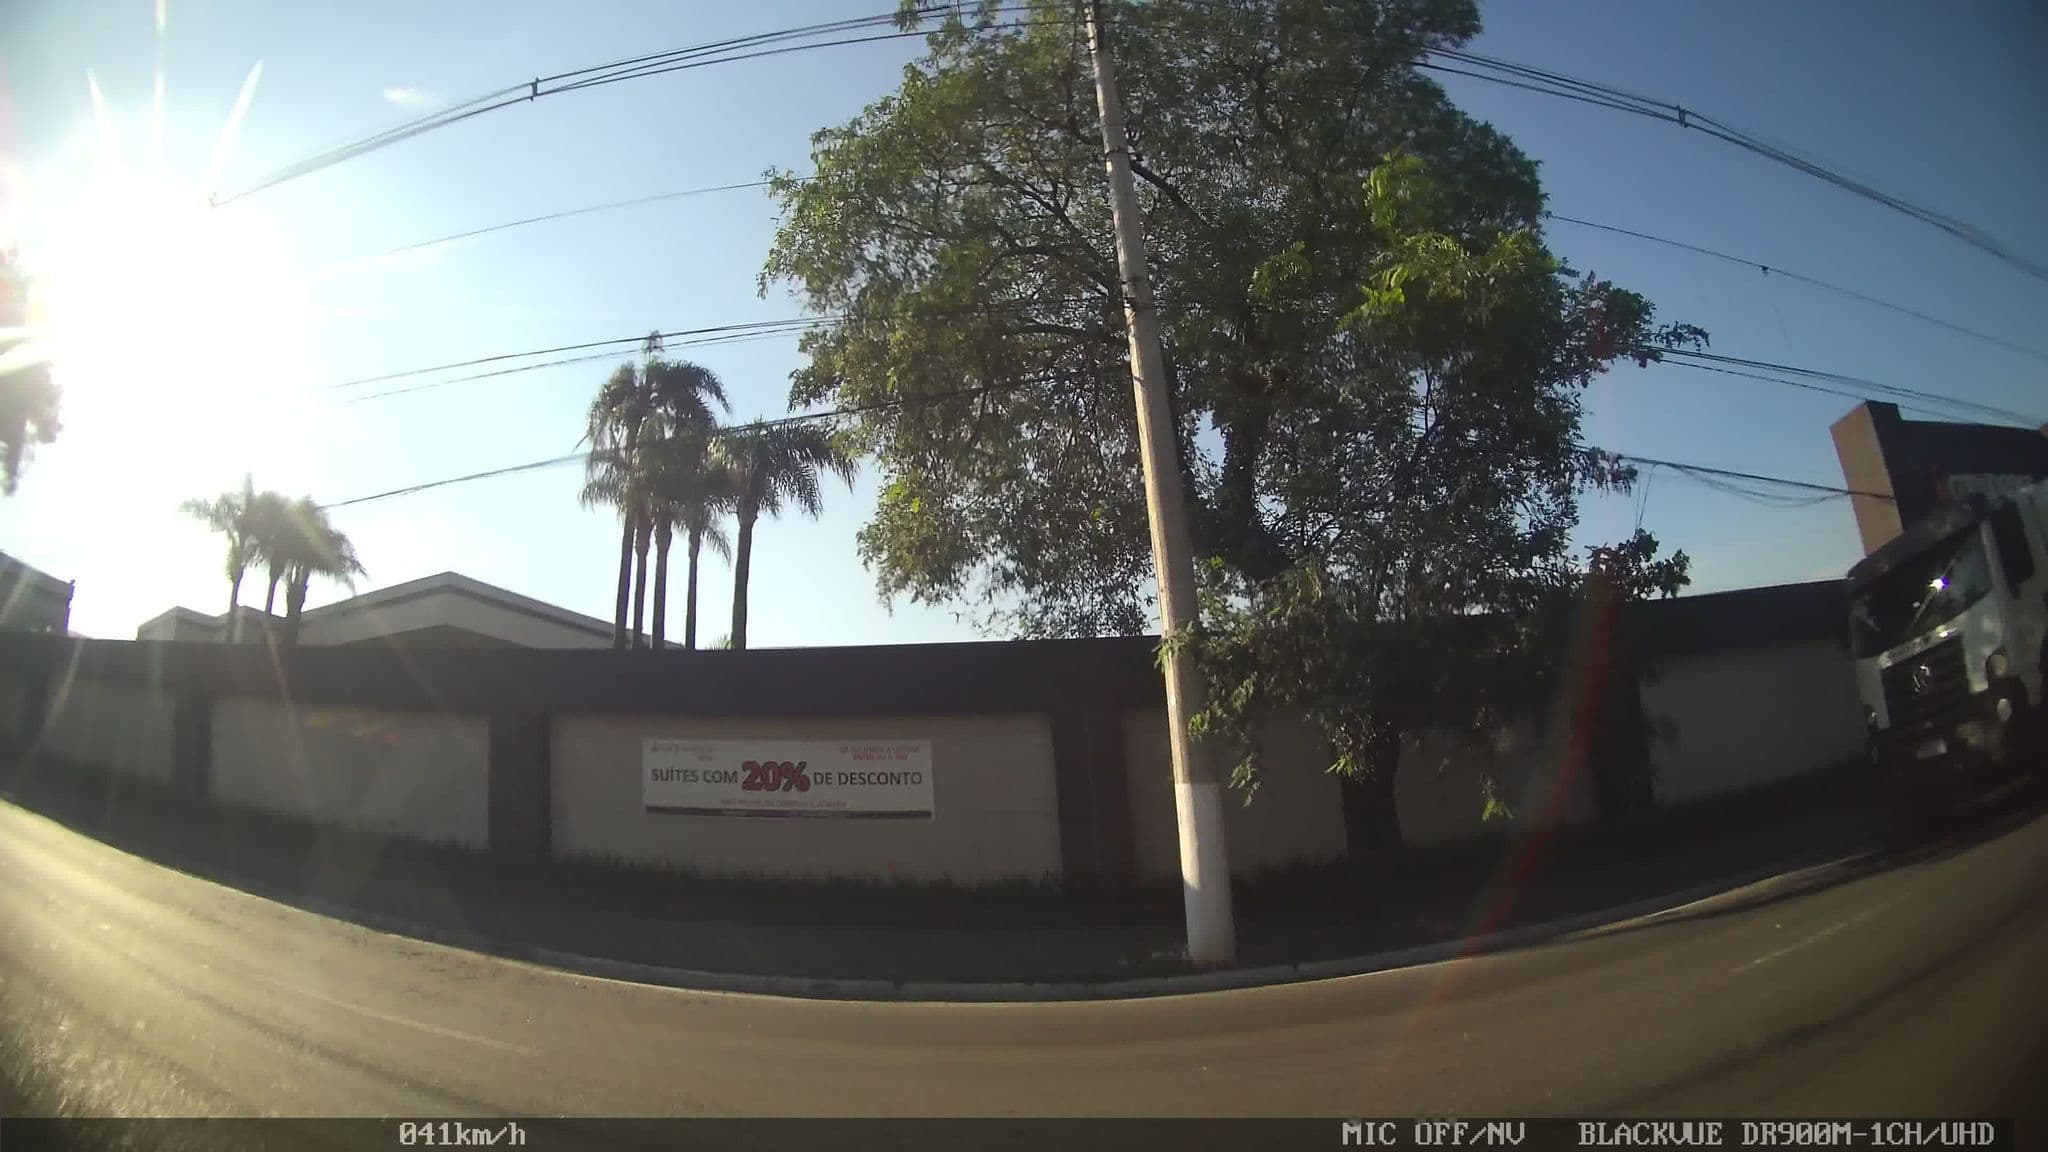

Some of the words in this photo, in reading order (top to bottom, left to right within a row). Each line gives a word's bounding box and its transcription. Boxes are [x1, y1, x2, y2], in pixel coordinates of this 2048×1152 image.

[651, 767, 698, 785] SUÍTES
[703, 770, 738, 785] COM
[741, 760, 812, 792] 20%
[813, 772, 833, 786] DE
[838, 772, 924, 786] DESCONTO
